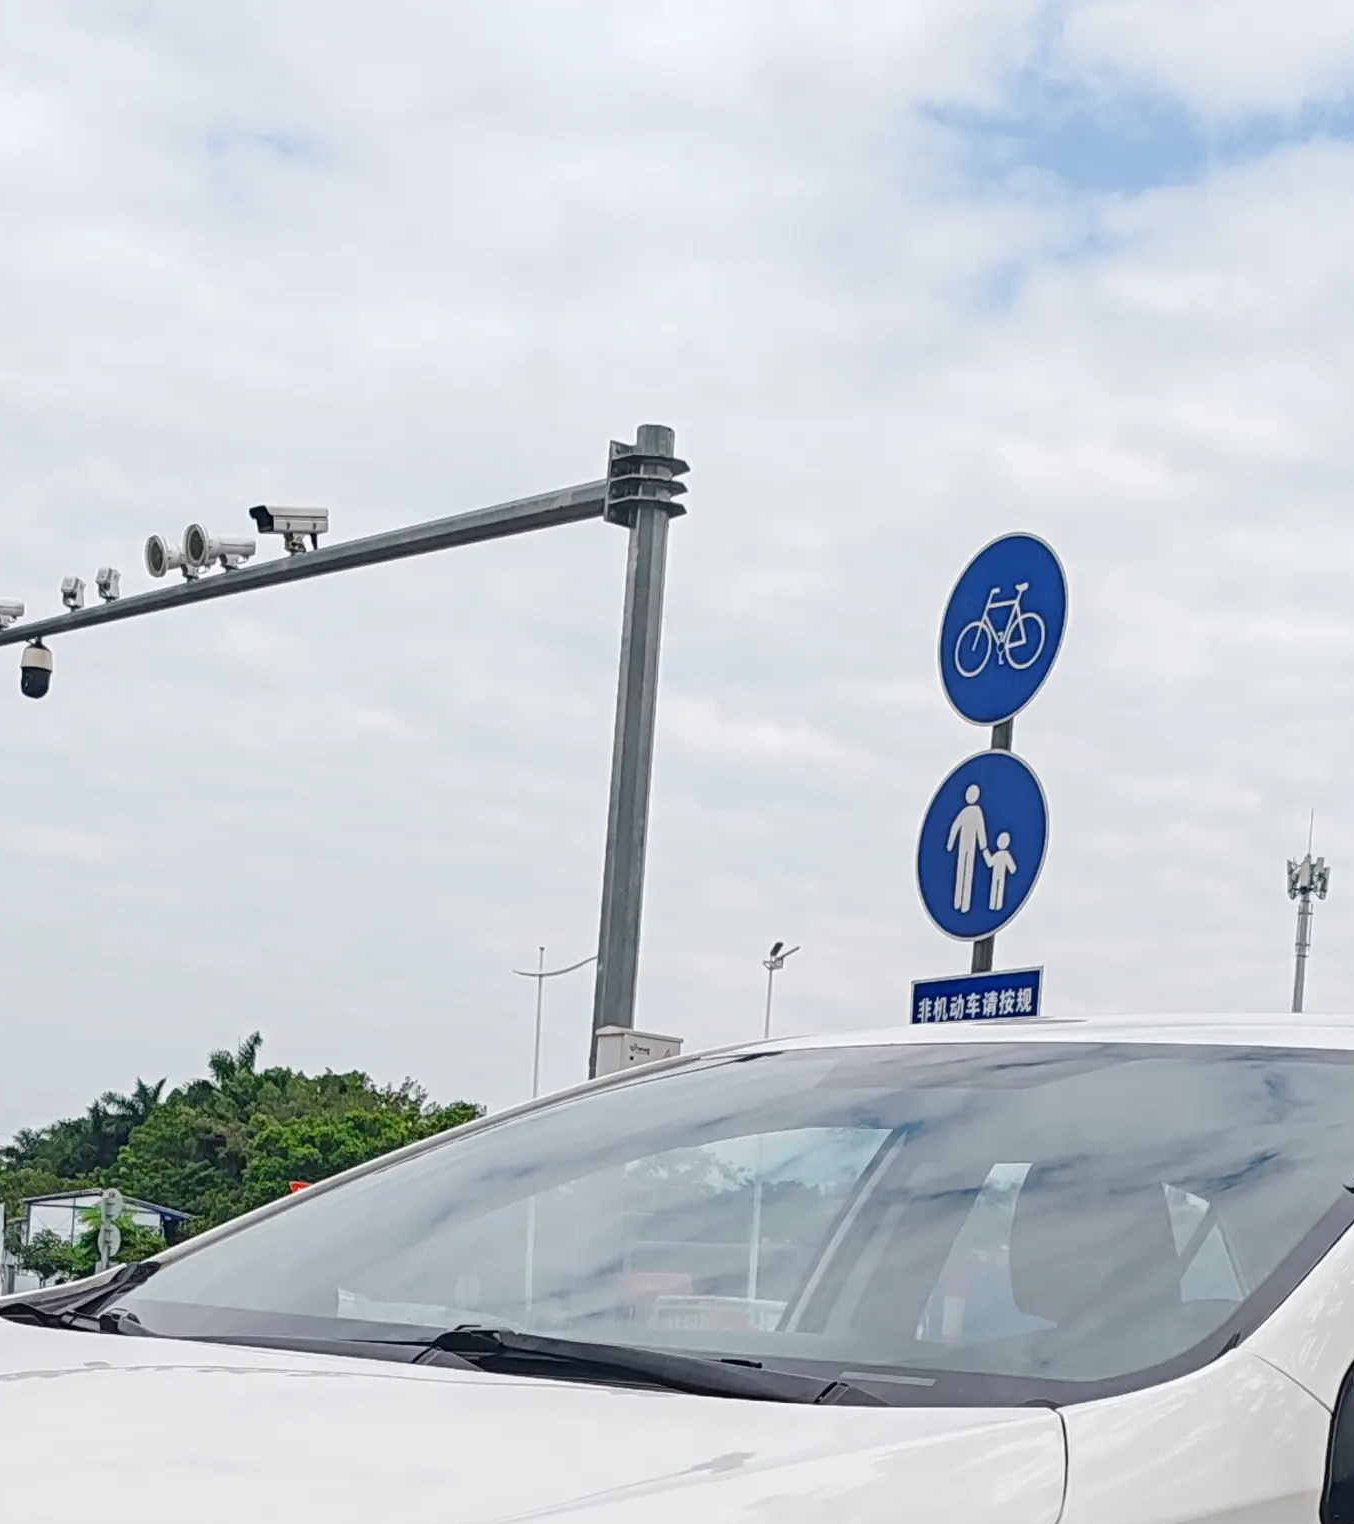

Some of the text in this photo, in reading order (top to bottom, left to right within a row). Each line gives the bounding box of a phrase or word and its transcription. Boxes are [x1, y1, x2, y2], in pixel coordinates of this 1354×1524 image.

[917, 987, 1033, 1022] 非机动车请按规
